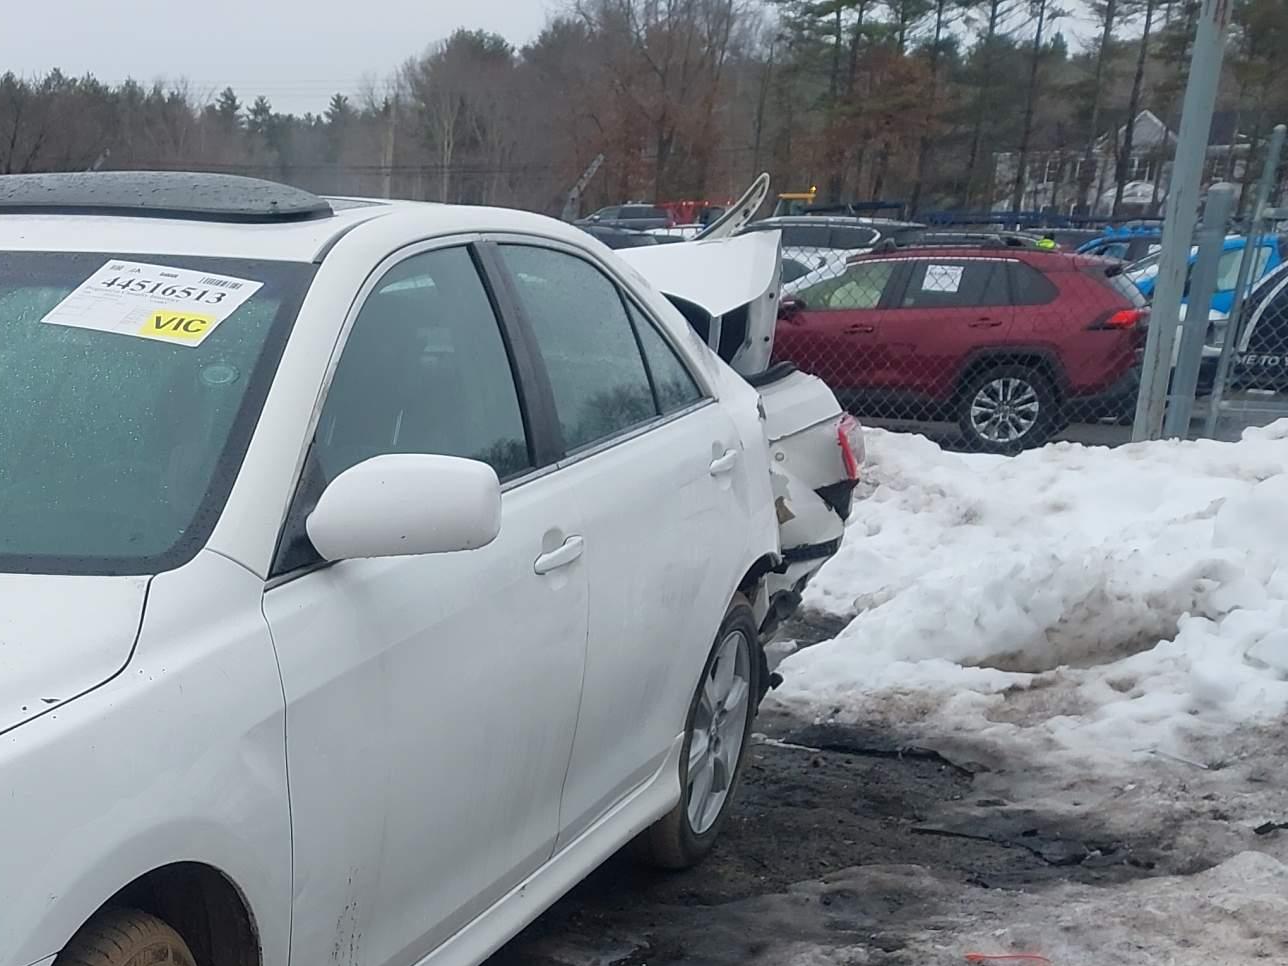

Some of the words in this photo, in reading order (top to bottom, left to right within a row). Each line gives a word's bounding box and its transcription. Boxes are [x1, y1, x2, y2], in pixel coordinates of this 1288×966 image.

[101, 276, 227, 304] 44516513
[154, 315, 208, 333] VIC
[1260, 355, 1280, 366] TO
